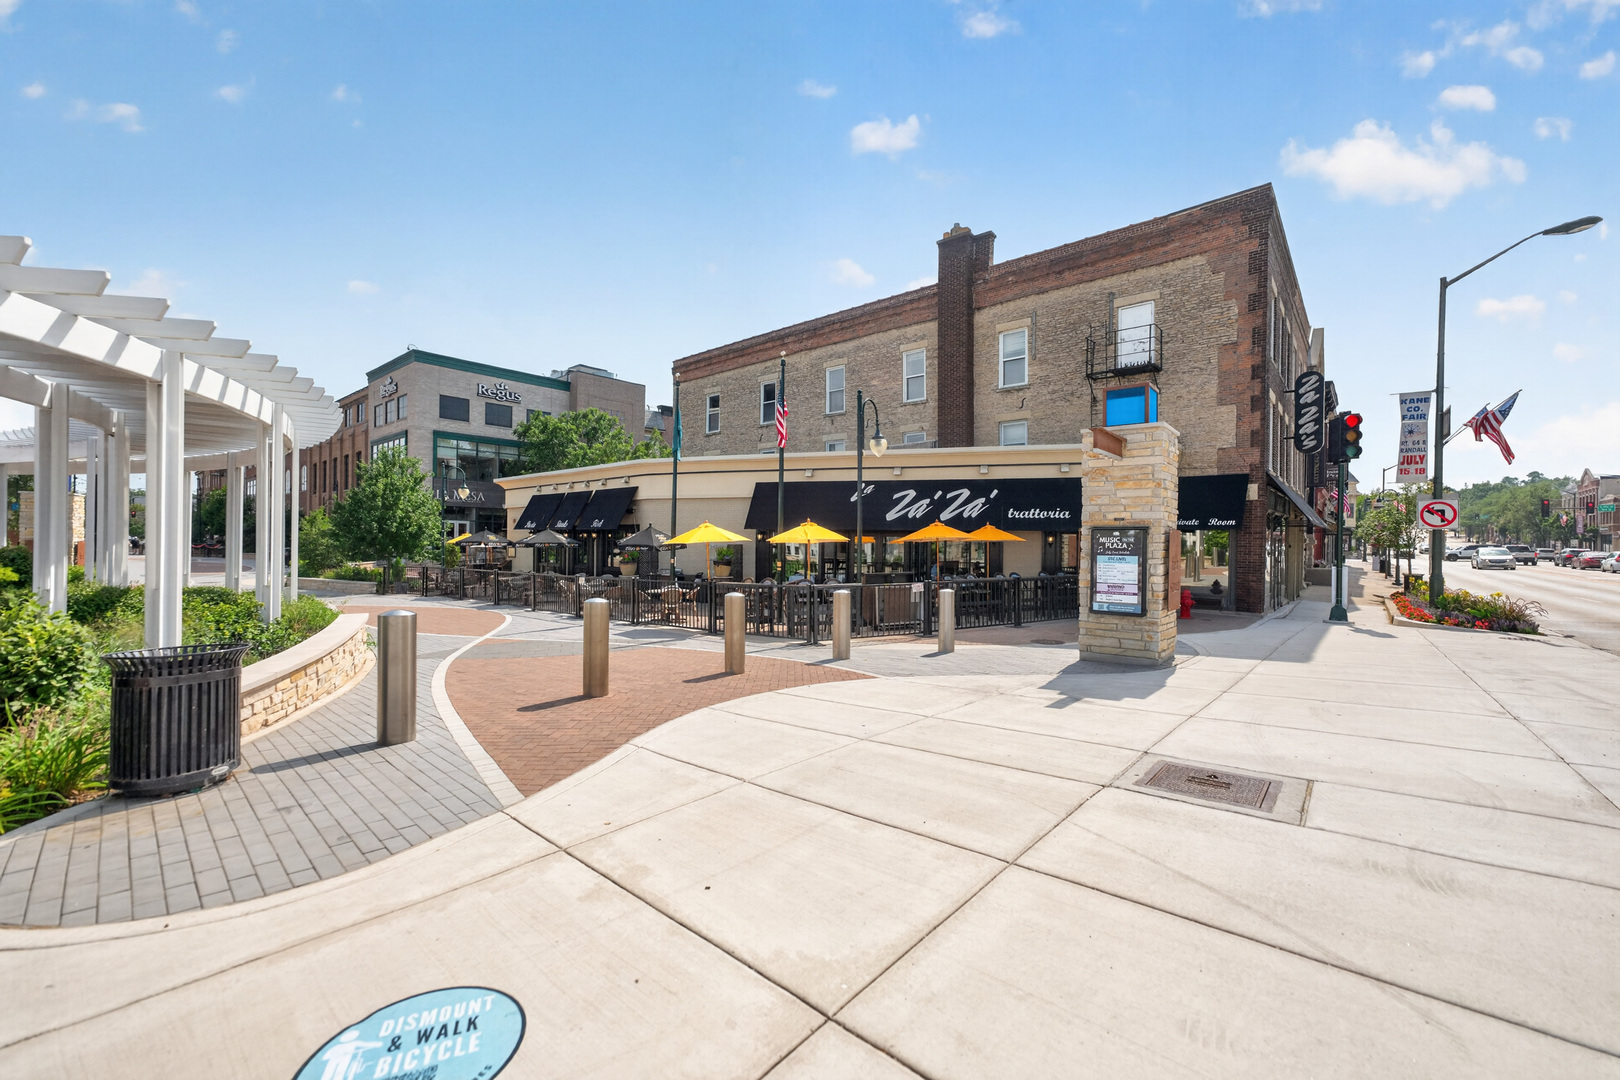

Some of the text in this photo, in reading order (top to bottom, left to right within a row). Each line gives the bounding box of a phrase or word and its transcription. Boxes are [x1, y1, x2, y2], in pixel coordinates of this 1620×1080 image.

[478, 383, 522, 402] Regus
[1401, 397, 1430, 405] KANE
[1400, 455, 1425, 466] JULY
[1008, 508, 1071, 519] trattoria
[1207, 517, 1237, 526] Room
[378, 994, 496, 1038] DISMOUNT
[387, 1015, 479, 1053] & WALK
[373, 1031, 482, 1079] BICYCLE
